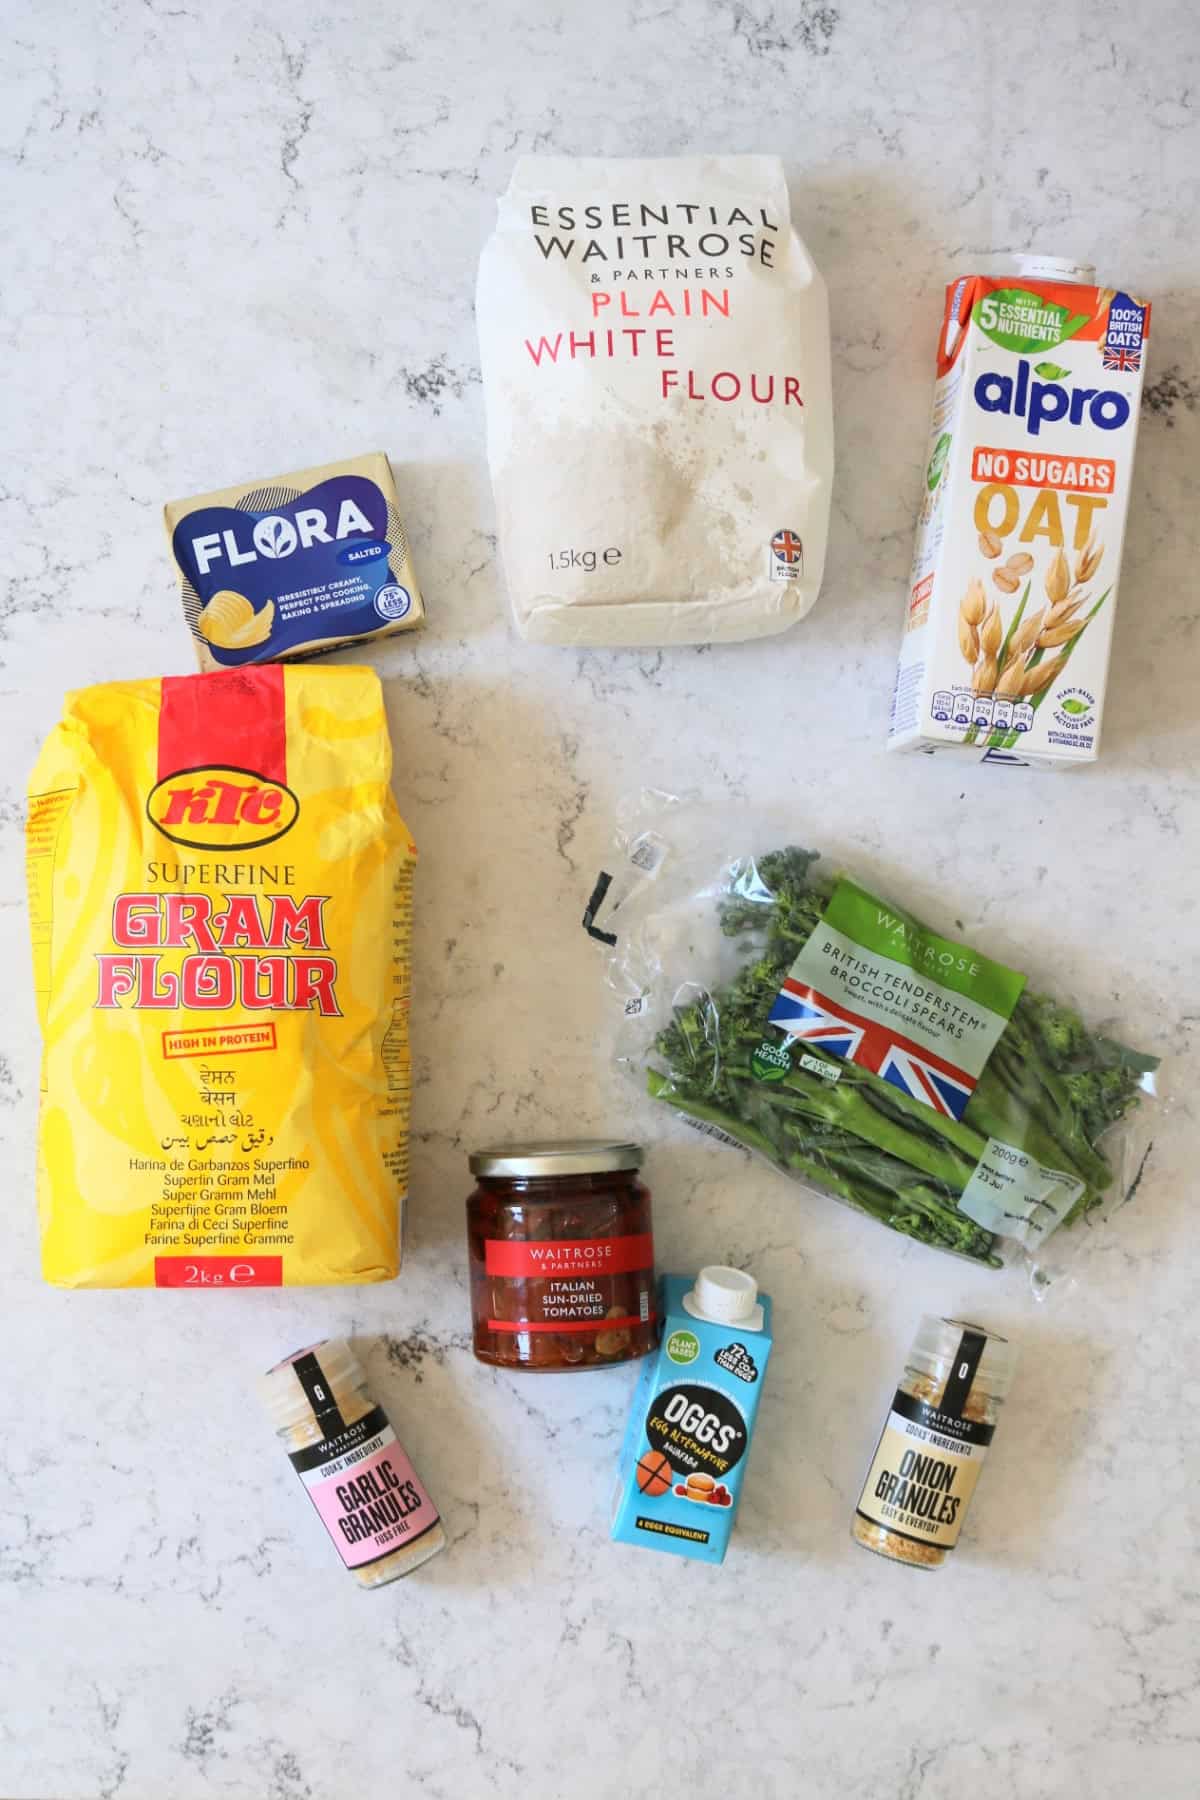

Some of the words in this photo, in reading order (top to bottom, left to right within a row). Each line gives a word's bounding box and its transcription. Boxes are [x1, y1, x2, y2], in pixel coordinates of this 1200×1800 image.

[531, 204, 778, 232] ESSENTIAL
[534, 234, 775, 268] WAITROSE
[590, 273, 601, 283] &
[613, 267, 734, 281] PARTNERS
[591, 289, 730, 318] PLAIN
[980, 298, 998, 330] 5
[999, 304, 1062, 328] ESSENTIAL
[1111, 308, 1143, 323] 100%
[997, 318, 1061, 343] NUTRIENTS
[1107, 332, 1141, 347] OATS
[1109, 321, 1142, 333] BRITISH
[525, 329, 675, 366] WHITE
[662, 370, 804, 407] FLOUR
[974, 359, 1130, 436] alpro
[977, 453, 1008, 477] NO
[1015, 458, 1111, 488] SUGARS
[974, 482, 1108, 550] OAT
[192, 499, 374, 575] FLORA
[348, 547, 381, 561] SALTED
[549, 549, 596, 571] 1.5kg
[277, 585, 326, 602] IRRESISTIBLY
[280, 598, 313, 612] PERFECT
[315, 593, 331, 603] FOR
[281, 607, 311, 621] BAKING
[313, 605, 319, 613] &
[321, 594, 365, 610] SPREADING
[147, 862, 295, 886] SUPERFINE
[112, 893, 332, 953] GRAM
[876, 911, 982, 977] WAITROSE
[822, 942, 879, 980] BRITISH
[94, 954, 344, 1018] FLOUR
[829, 965, 908, 1008] BROCCOLI
[911, 1003, 964, 1040] SPEARS
[169, 1038, 199, 1050] HIGH
[202, 1036, 216, 1047] IN
[220, 1032, 270, 1046] PROTEIN
[761, 1042, 789, 1061] GOOD
[755, 1048, 790, 1070] HEALTH
[129, 1159, 166, 1171] Harina
[170, 1159, 184, 1171] de
[188, 1159, 250, 1171] Garbanzos
[254, 1158, 310, 1172] Superfino
[992, 1145, 1017, 1165] 200g
[164, 1174, 214, 1188] Superfin
[217, 1174, 249, 1186] Gram
[253, 1173, 276, 1185] Mel
[162, 1188, 197, 1203] Super
[200, 1189, 243, 1201] Gramm
[247, 1188, 277, 1200] Mehl
[151, 1203, 211, 1217] Superfijne
[214, 1204, 246, 1215] Gram
[251, 1203, 287, 1215] Bloem
[150, 1218, 184, 1230] Farina
[189, 1218, 199, 1230] di
[203, 1218, 228, 1230] Ceci
[232, 1218, 288, 1232] Superfine
[145, 1233, 179, 1245] Farine
[183, 1233, 240, 1247] Superfine
[243, 1233, 294, 1245] Gramme
[530, 1246, 612, 1260] WAITROSE
[551, 1260, 602, 1271] PARTNERS
[185, 1265, 224, 1285] 2kg
[550, 1281, 595, 1292] ITALIAN
[543, 1293, 602, 1304] SUN-DRIED
[543, 1305, 604, 1317] TOMATOES
[671, 1337, 697, 1349] PLANT
[664, 1393, 735, 1453] OGGS
[922, 1407, 973, 1432] WAITROSE
[318, 1422, 367, 1454] WAITROSE
[650, 1416, 669, 1437] EGG
[671, 1426, 729, 1472] ALTERNATIVE
[929, 1431, 973, 1456] INGREDIENTS
[344, 1437, 384, 1467] INGREDIENTS
[899, 1449, 958, 1493] ONION
[336, 1460, 400, 1513] GARLIC
[875, 1471, 960, 1525] GRANULES
[338, 1480, 422, 1545] GRANULES
[881, 1507, 898, 1520] EASY
[906, 1517, 939, 1535] EVERYDAY
[374, 1530, 395, 1546] FUSS
[394, 1521, 411, 1538] FREE
[664, 1523, 708, 1541] EQUIVALENT
